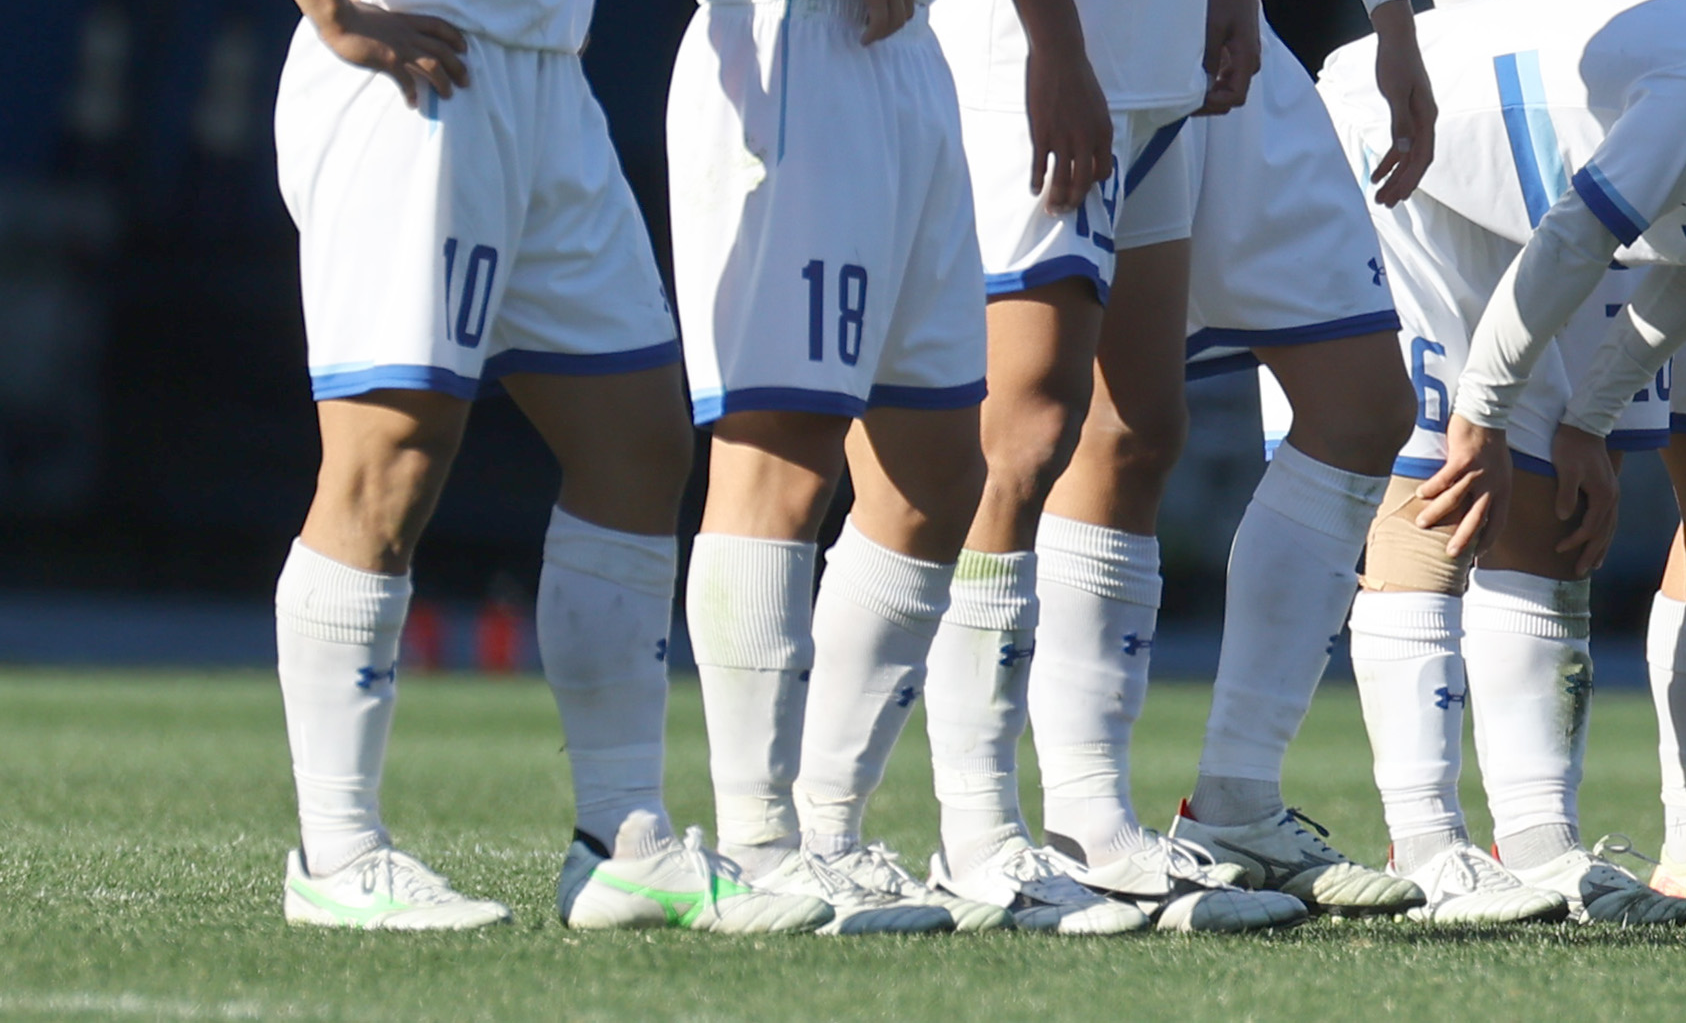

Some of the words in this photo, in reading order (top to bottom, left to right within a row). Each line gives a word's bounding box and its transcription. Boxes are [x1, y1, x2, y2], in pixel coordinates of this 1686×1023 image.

[443, 236, 498, 349] 10
[801, 259, 868, 367] 18
[1411, 336, 1449, 434] 6
